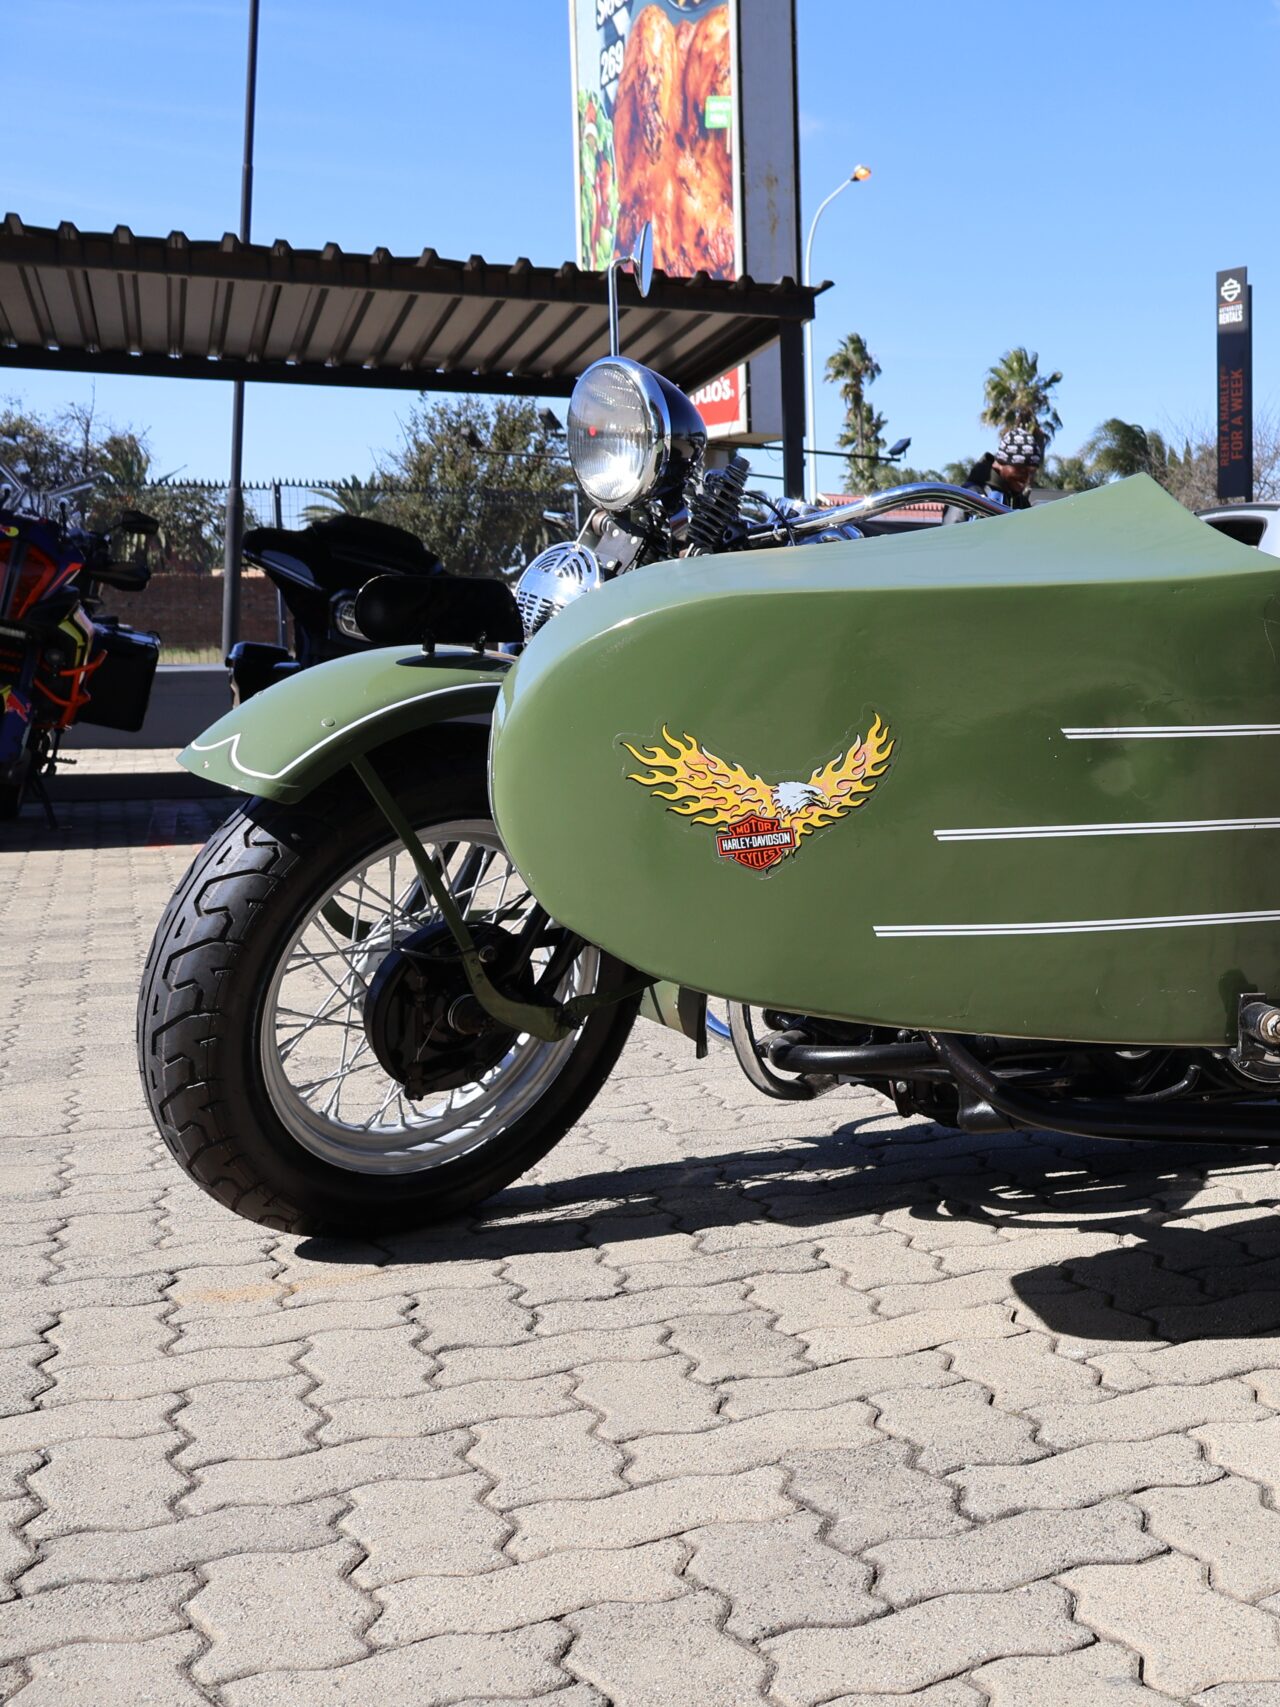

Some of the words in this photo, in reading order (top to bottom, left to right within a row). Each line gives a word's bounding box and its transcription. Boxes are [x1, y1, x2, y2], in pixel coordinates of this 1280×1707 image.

[601, 40, 624, 86] 269
[1231, 368, 1243, 411] WEEK
[1220, 423, 1230, 432] A
[1231, 415, 1243, 426] A
[1220, 436, 1230, 467] RENT
[1231, 430, 1243, 460] FOR
[736, 820, 772, 834] MOTOR
[722, 832, 791, 851] HARLEY-DAVIDSON
[740, 849, 776, 866] CYCLES
